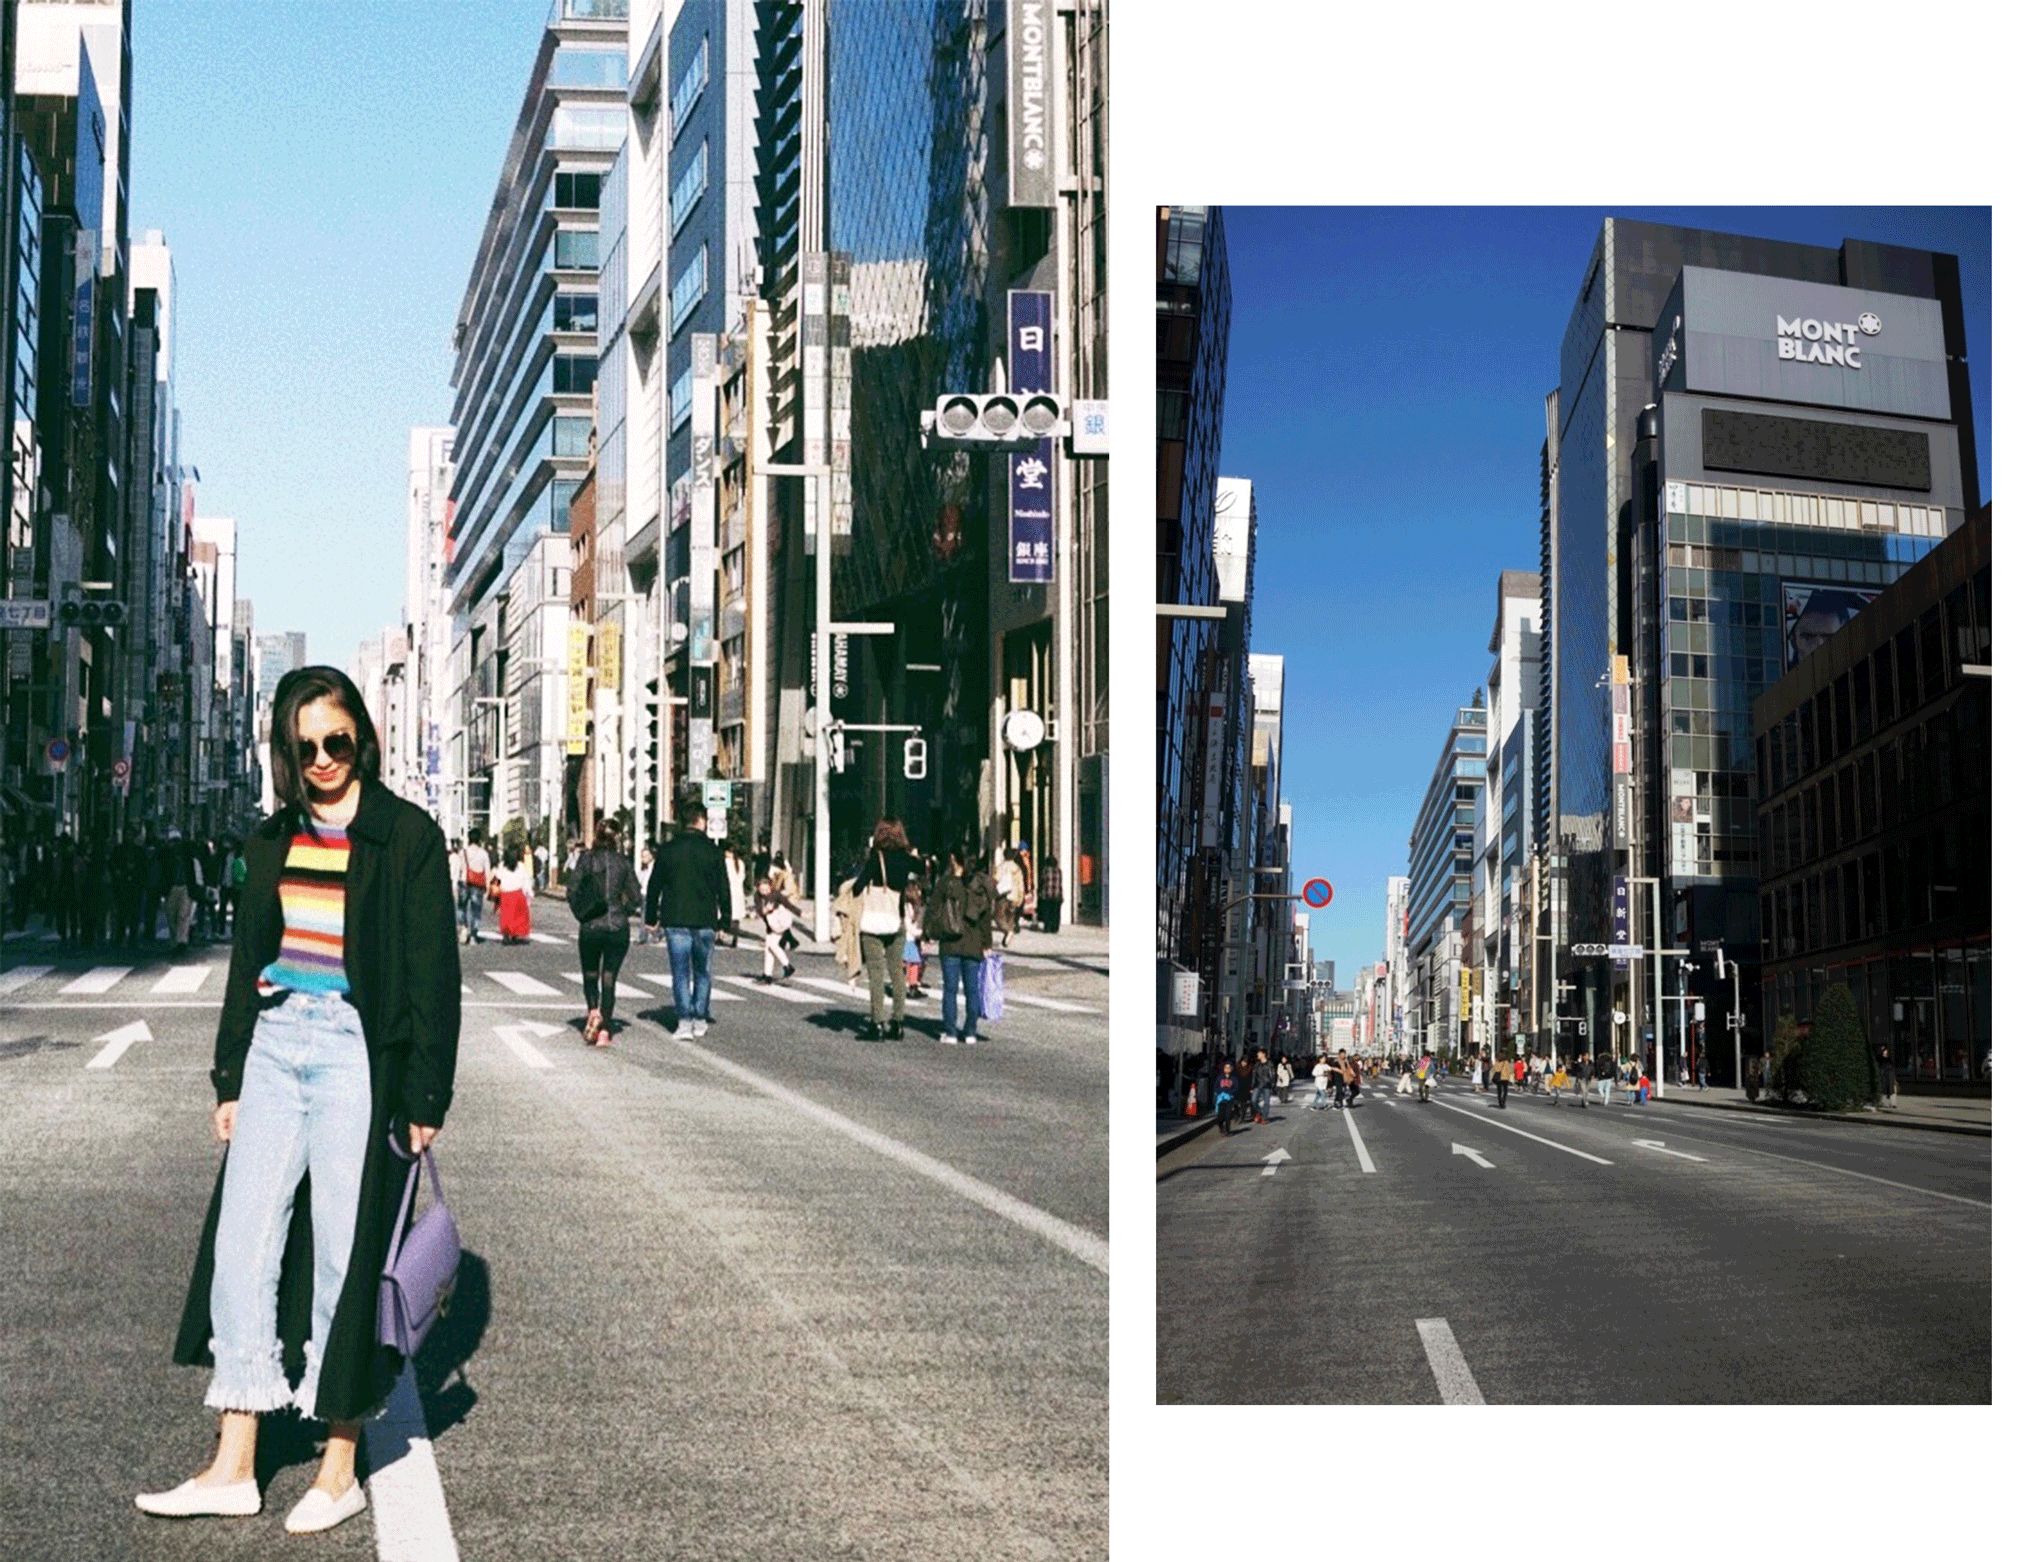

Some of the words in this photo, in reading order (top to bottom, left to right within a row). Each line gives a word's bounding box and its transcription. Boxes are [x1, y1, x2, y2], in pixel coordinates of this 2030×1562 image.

[1022, 2, 1044, 149] MONTBLANC
[1776, 314, 1859, 345] MONT
[1777, 337, 1862, 369] BLANC
[1016, 326, 1048, 490] 日堂
[695, 437, 711, 487] ダンス
[1016, 541, 1049, 558] 銀座
[1617, 783, 1625, 832] MONTBLANC
[1616, 886, 1627, 941] 日新堂
